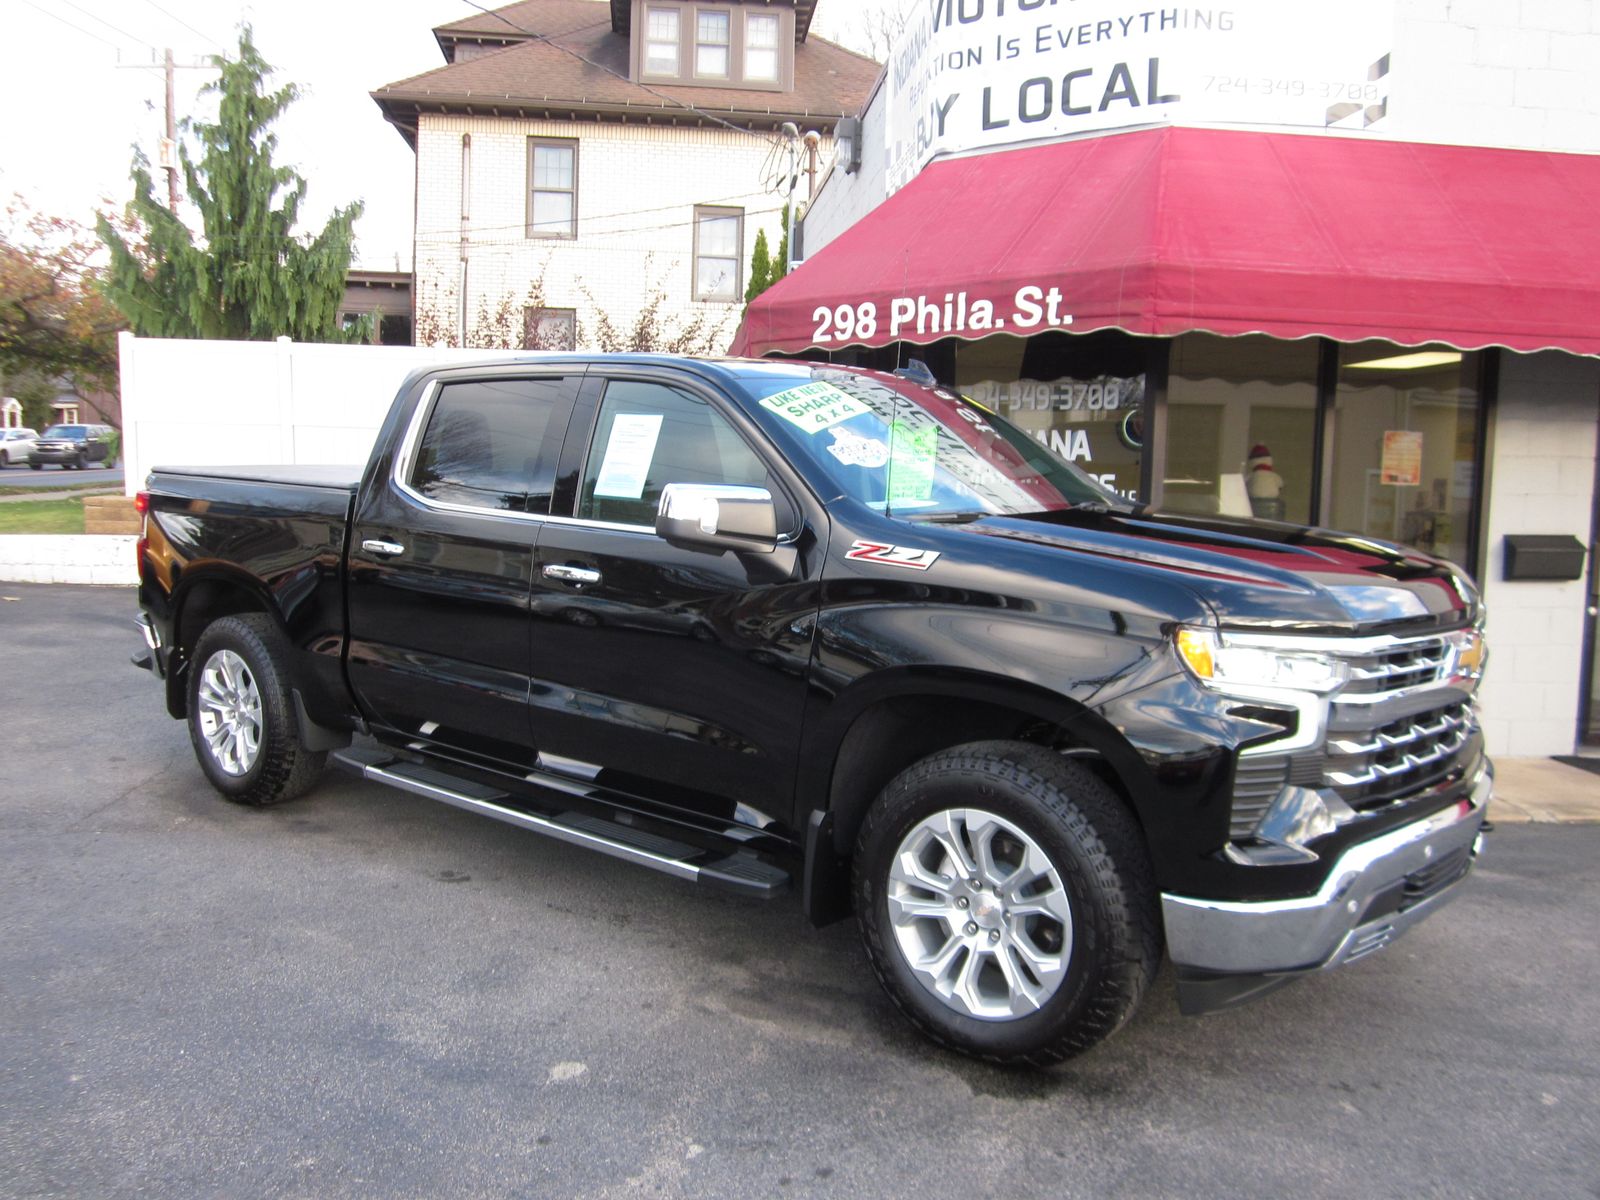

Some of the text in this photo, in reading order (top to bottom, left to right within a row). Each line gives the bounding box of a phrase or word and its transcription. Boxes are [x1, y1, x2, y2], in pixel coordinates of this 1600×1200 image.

[1035, 8, 1235, 54] EVERYTHING
[1202, 75, 1378, 100] 724-349-3700
[917, 57, 1181, 160] BUY LOCAL
[812, 286, 1073, 343] 298 Phila. St.
[768, 382, 829, 408] LIKE NEW
[787, 392, 842, 417] SHARP
[845, 540, 941, 571] Z71
